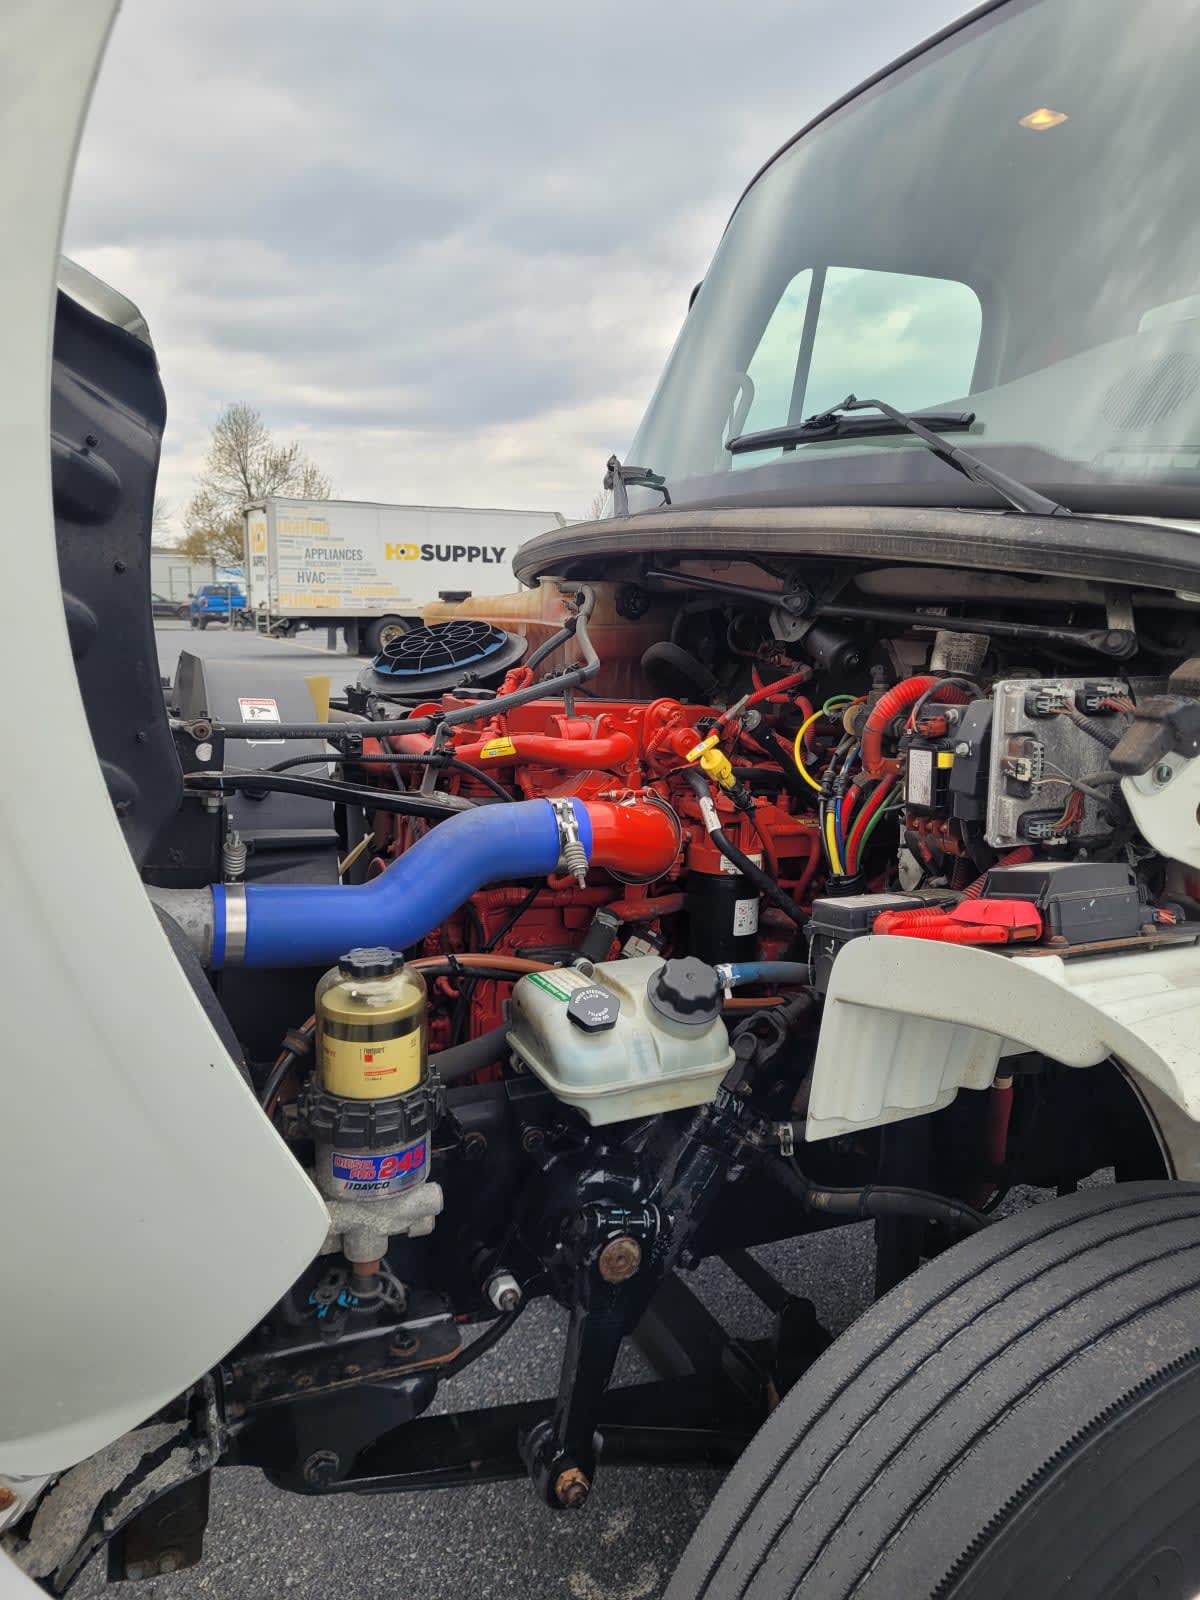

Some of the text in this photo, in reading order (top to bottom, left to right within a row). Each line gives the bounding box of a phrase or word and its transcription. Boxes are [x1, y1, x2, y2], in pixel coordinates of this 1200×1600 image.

[304, 547, 363, 561] APPLIANCES
[297, 571, 326, 584] HVAC
[334, 1156, 374, 1169] DIESEL
[349, 1168, 376, 1180] PRO
[353, 1181, 391, 1191] DAYCO
